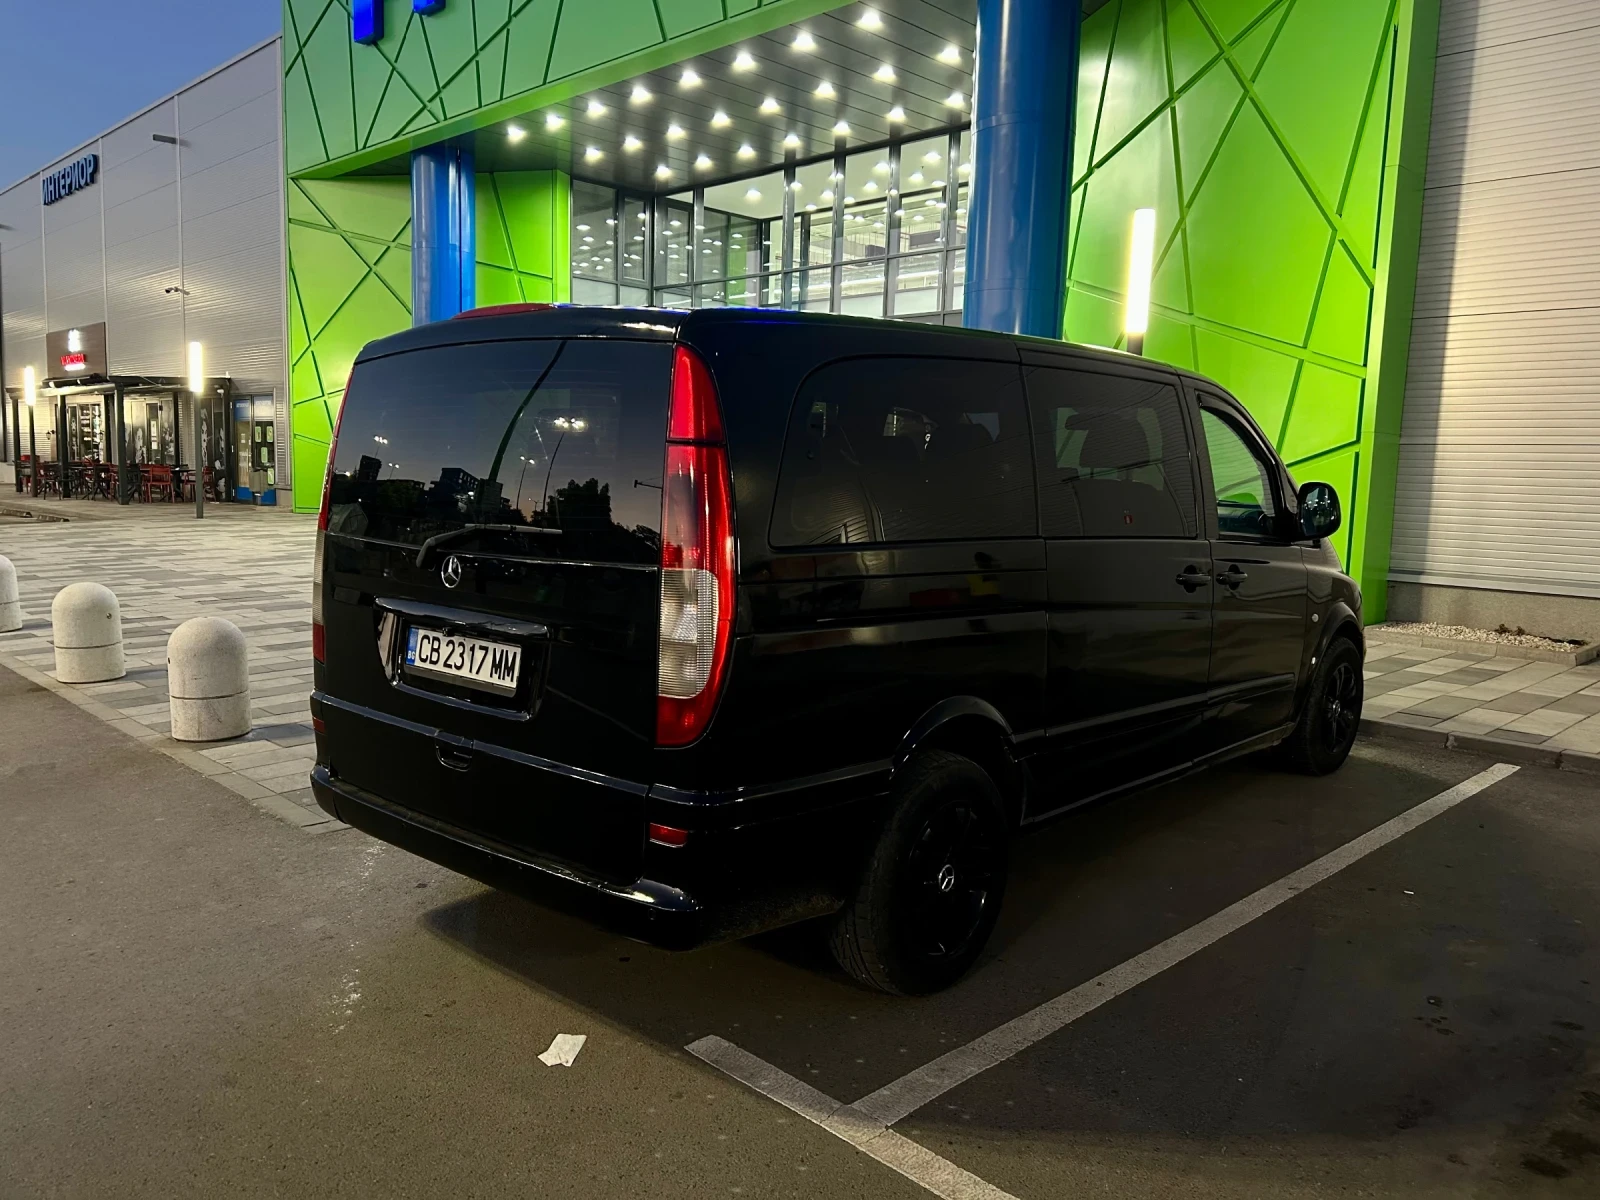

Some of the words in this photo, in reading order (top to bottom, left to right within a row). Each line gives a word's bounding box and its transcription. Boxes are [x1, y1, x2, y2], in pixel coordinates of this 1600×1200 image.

[42, 154, 97, 206] ИНТЕРИОР
[407, 650, 416, 660] BG
[442, 639, 489, 675] 2317
